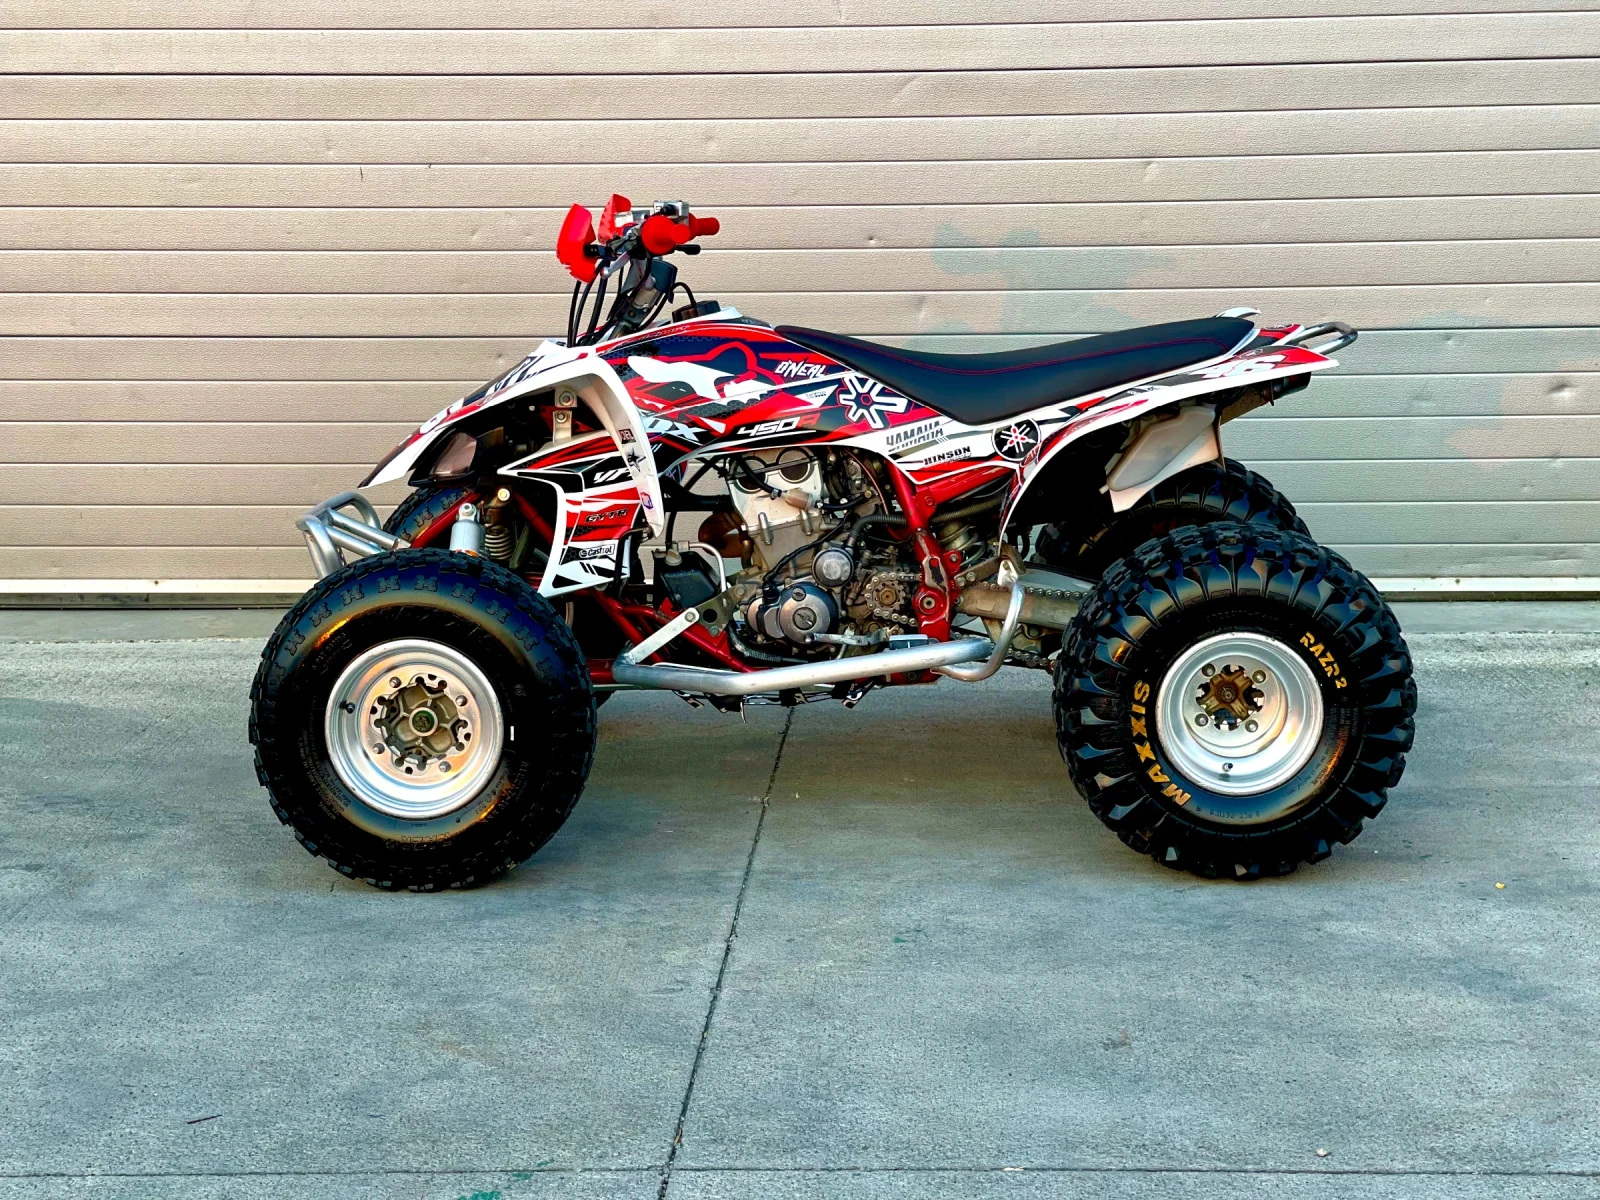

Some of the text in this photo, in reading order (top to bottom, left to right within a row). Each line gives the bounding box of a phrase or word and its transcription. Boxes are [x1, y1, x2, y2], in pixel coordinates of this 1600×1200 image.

[775, 360, 827, 379] O'NEAL
[737, 413, 821, 437] 450R
[886, 420, 944, 452] YAMAHA
[923, 445, 972, 467] HINSON
[585, 508, 629, 524] GYTR
[587, 545, 613, 558] Castrol
[1300, 632, 1340, 678] RAZR
[1335, 677, 1348, 690] 2
[1131, 680, 1192, 807] MAXXIS
